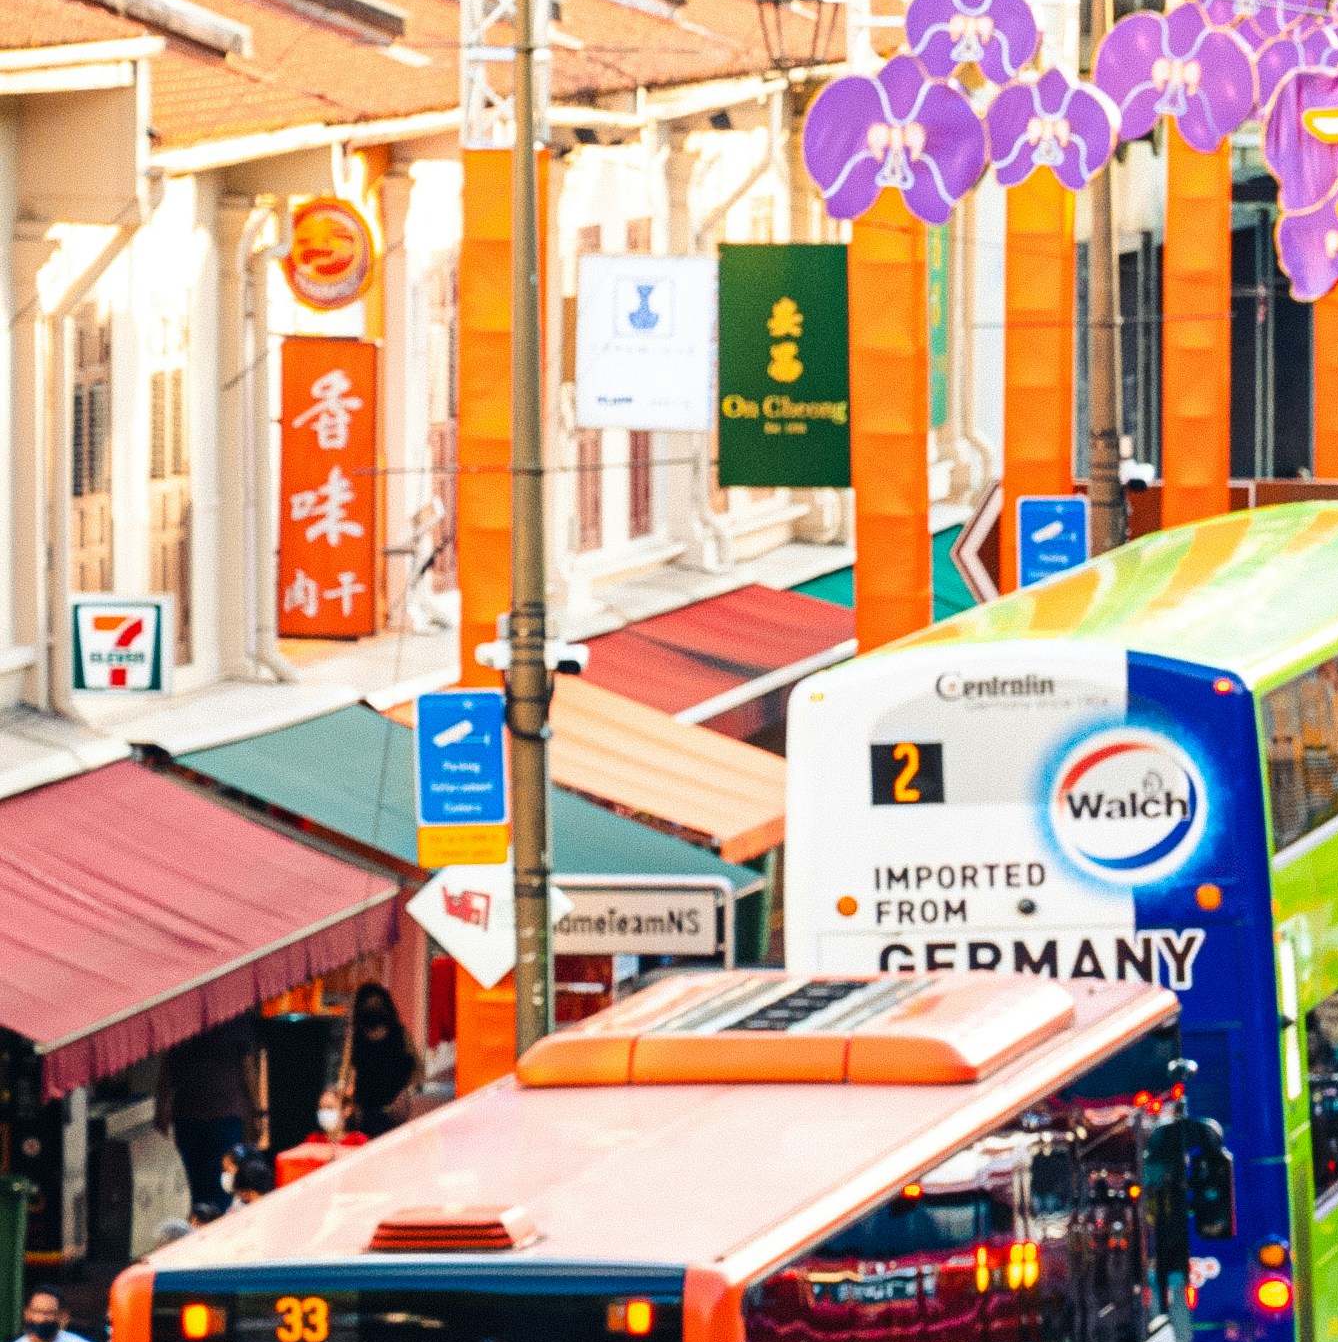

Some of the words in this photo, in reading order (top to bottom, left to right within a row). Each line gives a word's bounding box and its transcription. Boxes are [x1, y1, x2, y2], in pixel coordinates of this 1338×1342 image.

[722, 394, 759, 418] On
[763, 395, 848, 424] Cheong
[936, 671, 1055, 702] Centralin
[893, 742, 921, 803] 2
[1066, 789, 1190, 822] Walch
[875, 862, 1046, 890] IMPORTED
[553, 909, 701, 935] omeTeamNS
[876, 900, 967, 925] FROM
[879, 935, 1200, 983] GERMANY
